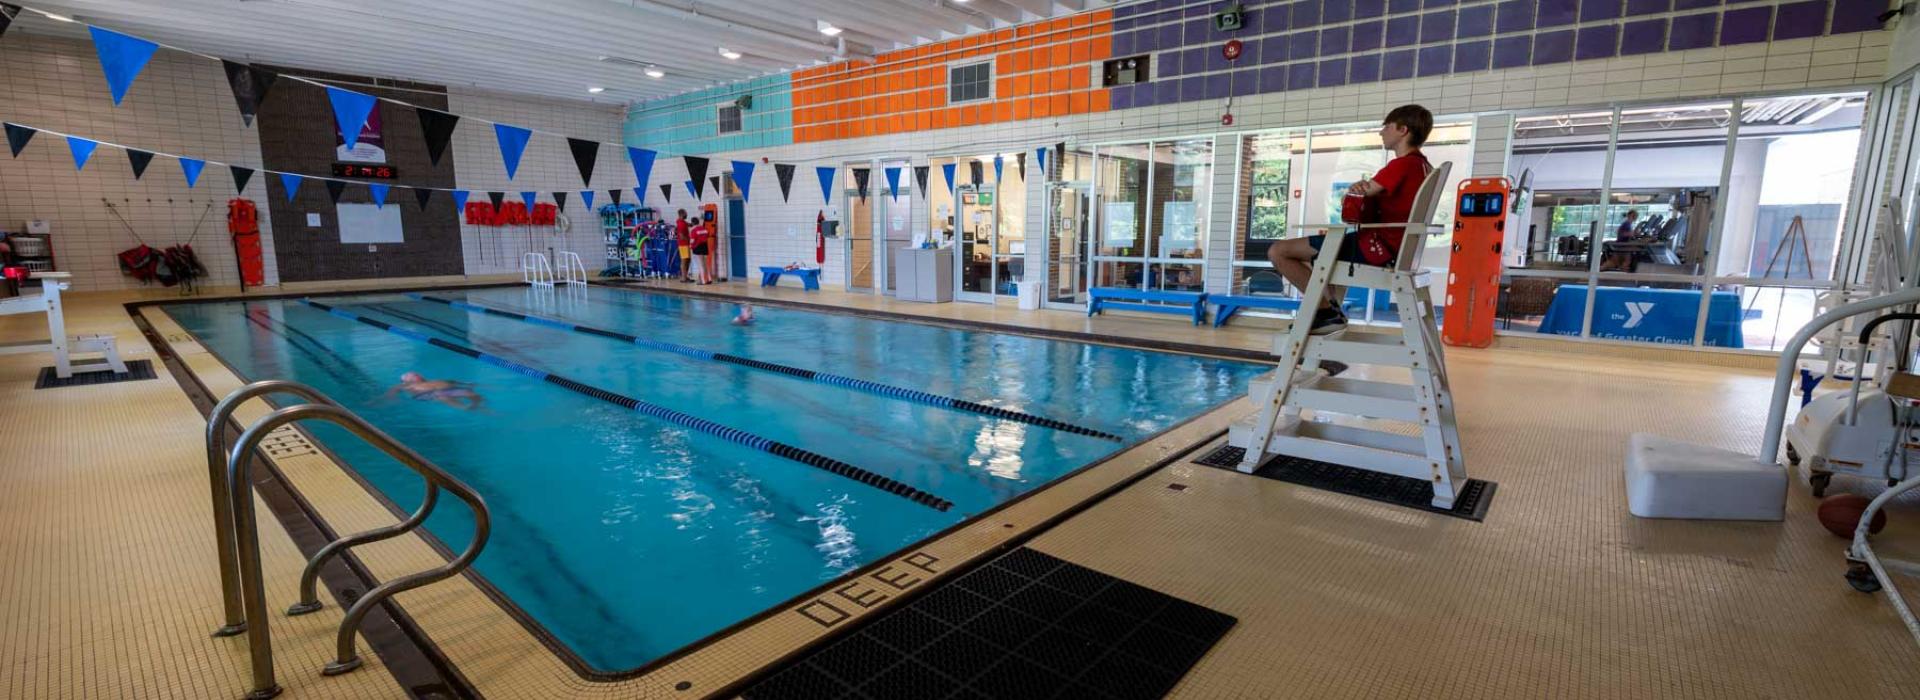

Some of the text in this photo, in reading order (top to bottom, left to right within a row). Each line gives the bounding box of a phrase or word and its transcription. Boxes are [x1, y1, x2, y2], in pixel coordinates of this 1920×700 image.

[1622, 302, 1656, 328] Y
[1655, 336, 1717, 347] Clevelnd
[263, 434, 318, 460] FEET
[795, 552, 940, 628] DEEP
